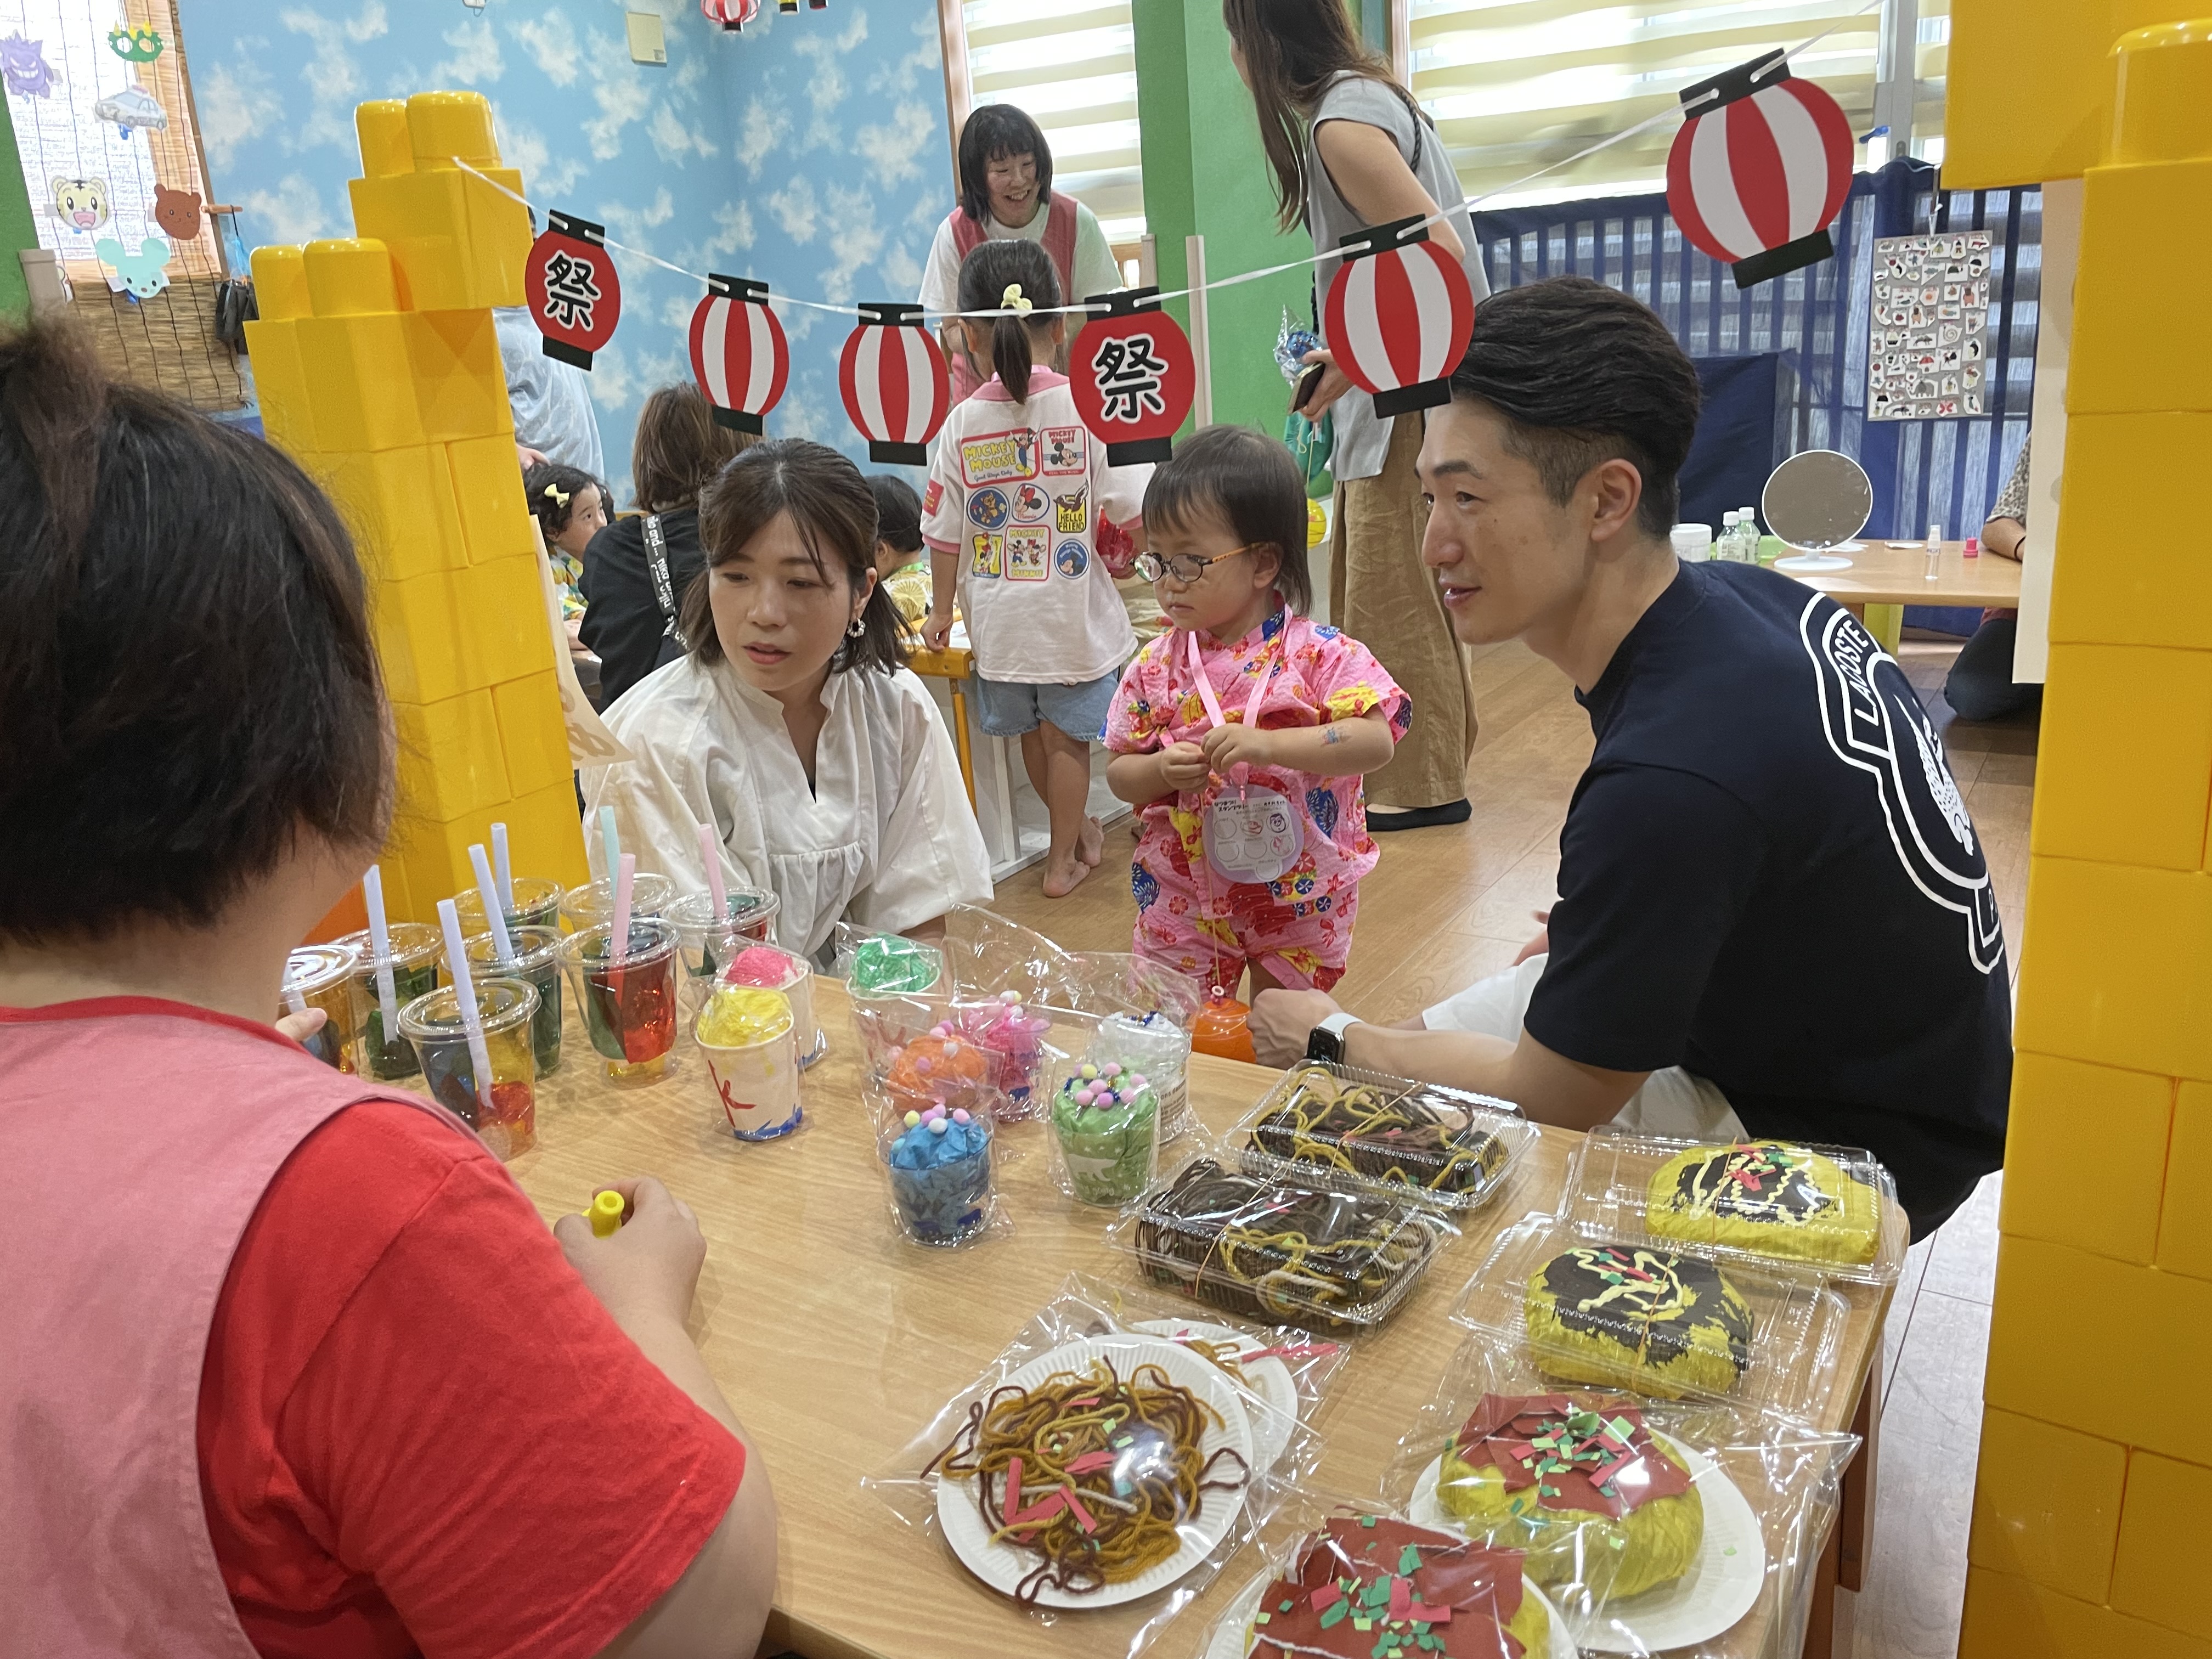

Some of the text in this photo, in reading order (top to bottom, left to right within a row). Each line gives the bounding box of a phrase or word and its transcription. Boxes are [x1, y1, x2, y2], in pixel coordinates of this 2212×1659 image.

[546, 252, 600, 329] 祭
[1094, 337, 1166, 420] 祭
[963, 441, 1015, 460] MICKEY
[969, 454, 1016, 472] MOUSE
[1059, 522, 1084, 531] FRIEND
[1834, 620, 1879, 726] LACOSTE
